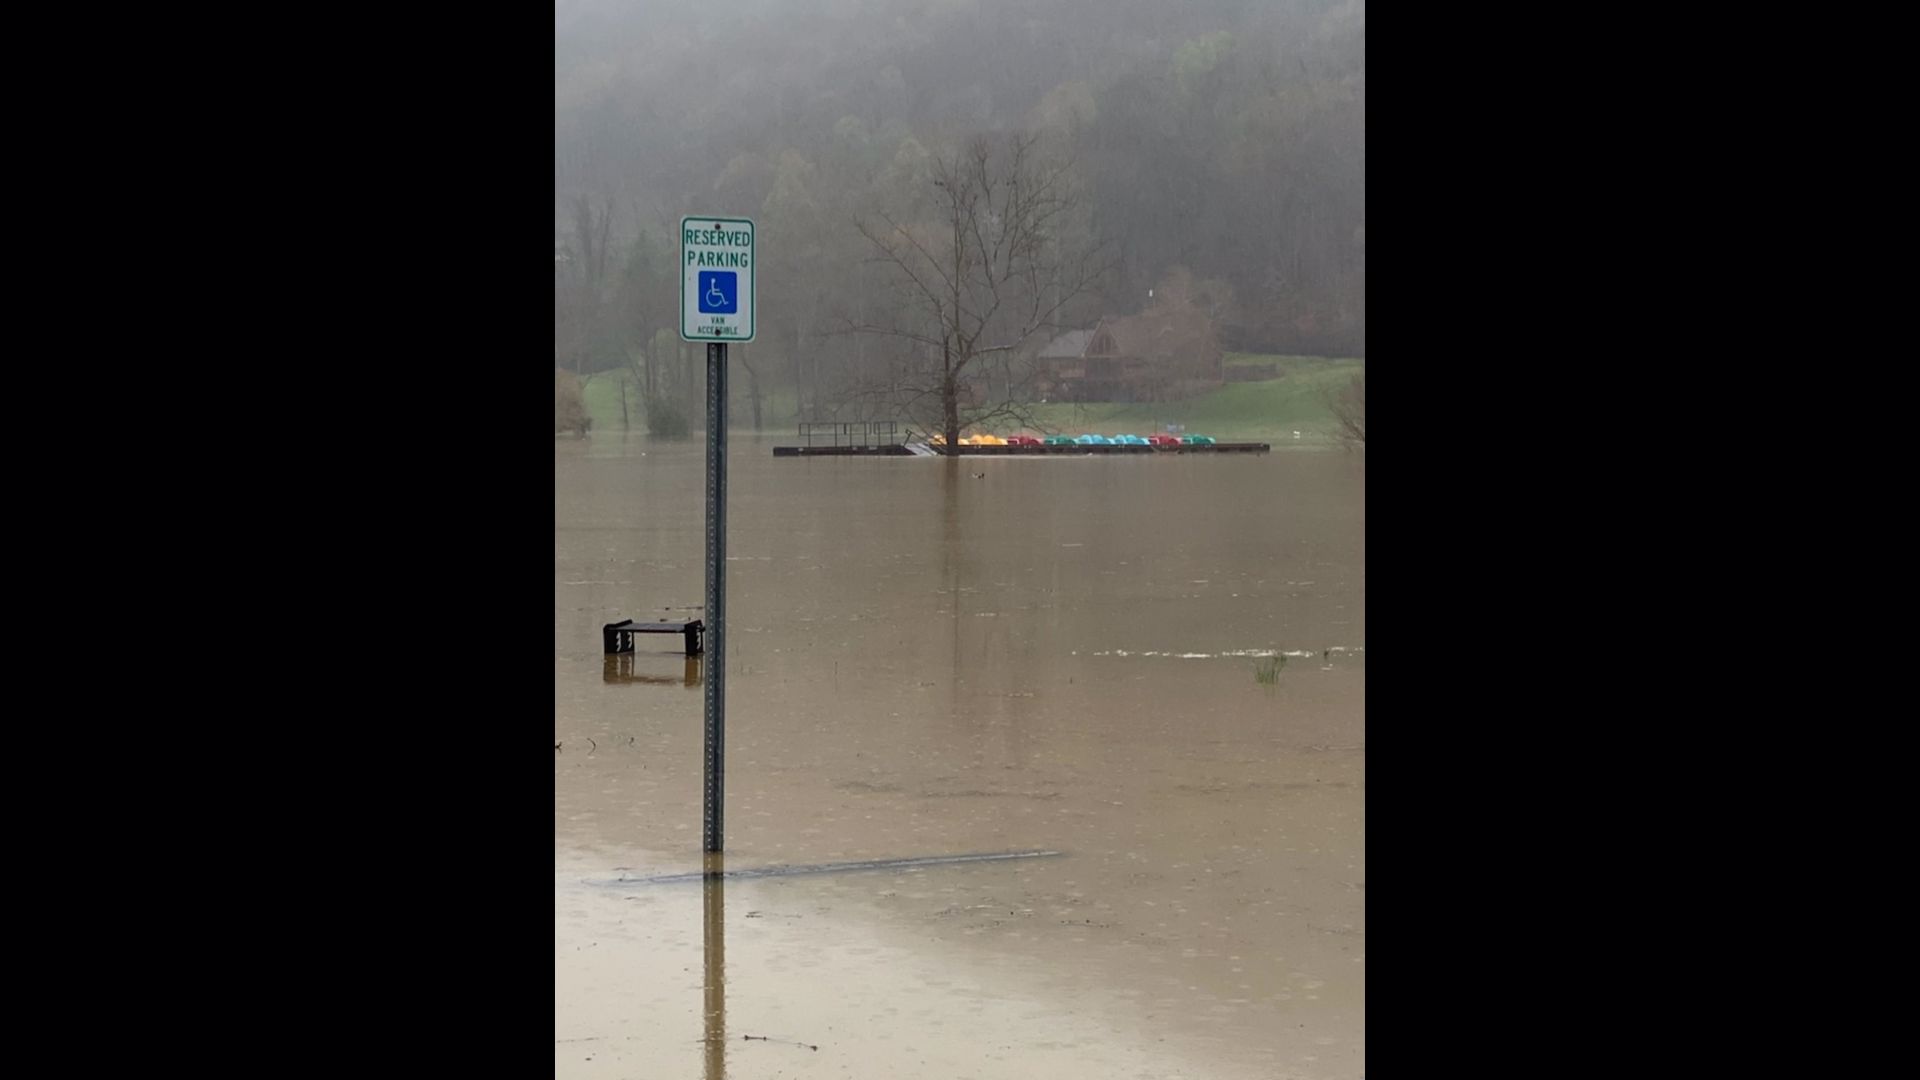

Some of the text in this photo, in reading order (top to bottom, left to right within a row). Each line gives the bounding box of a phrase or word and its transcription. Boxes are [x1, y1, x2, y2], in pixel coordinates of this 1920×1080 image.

[686, 229, 750, 247] RESERVED
[688, 250, 748, 268] PARKING
[711, 316, 725, 325] VAN
